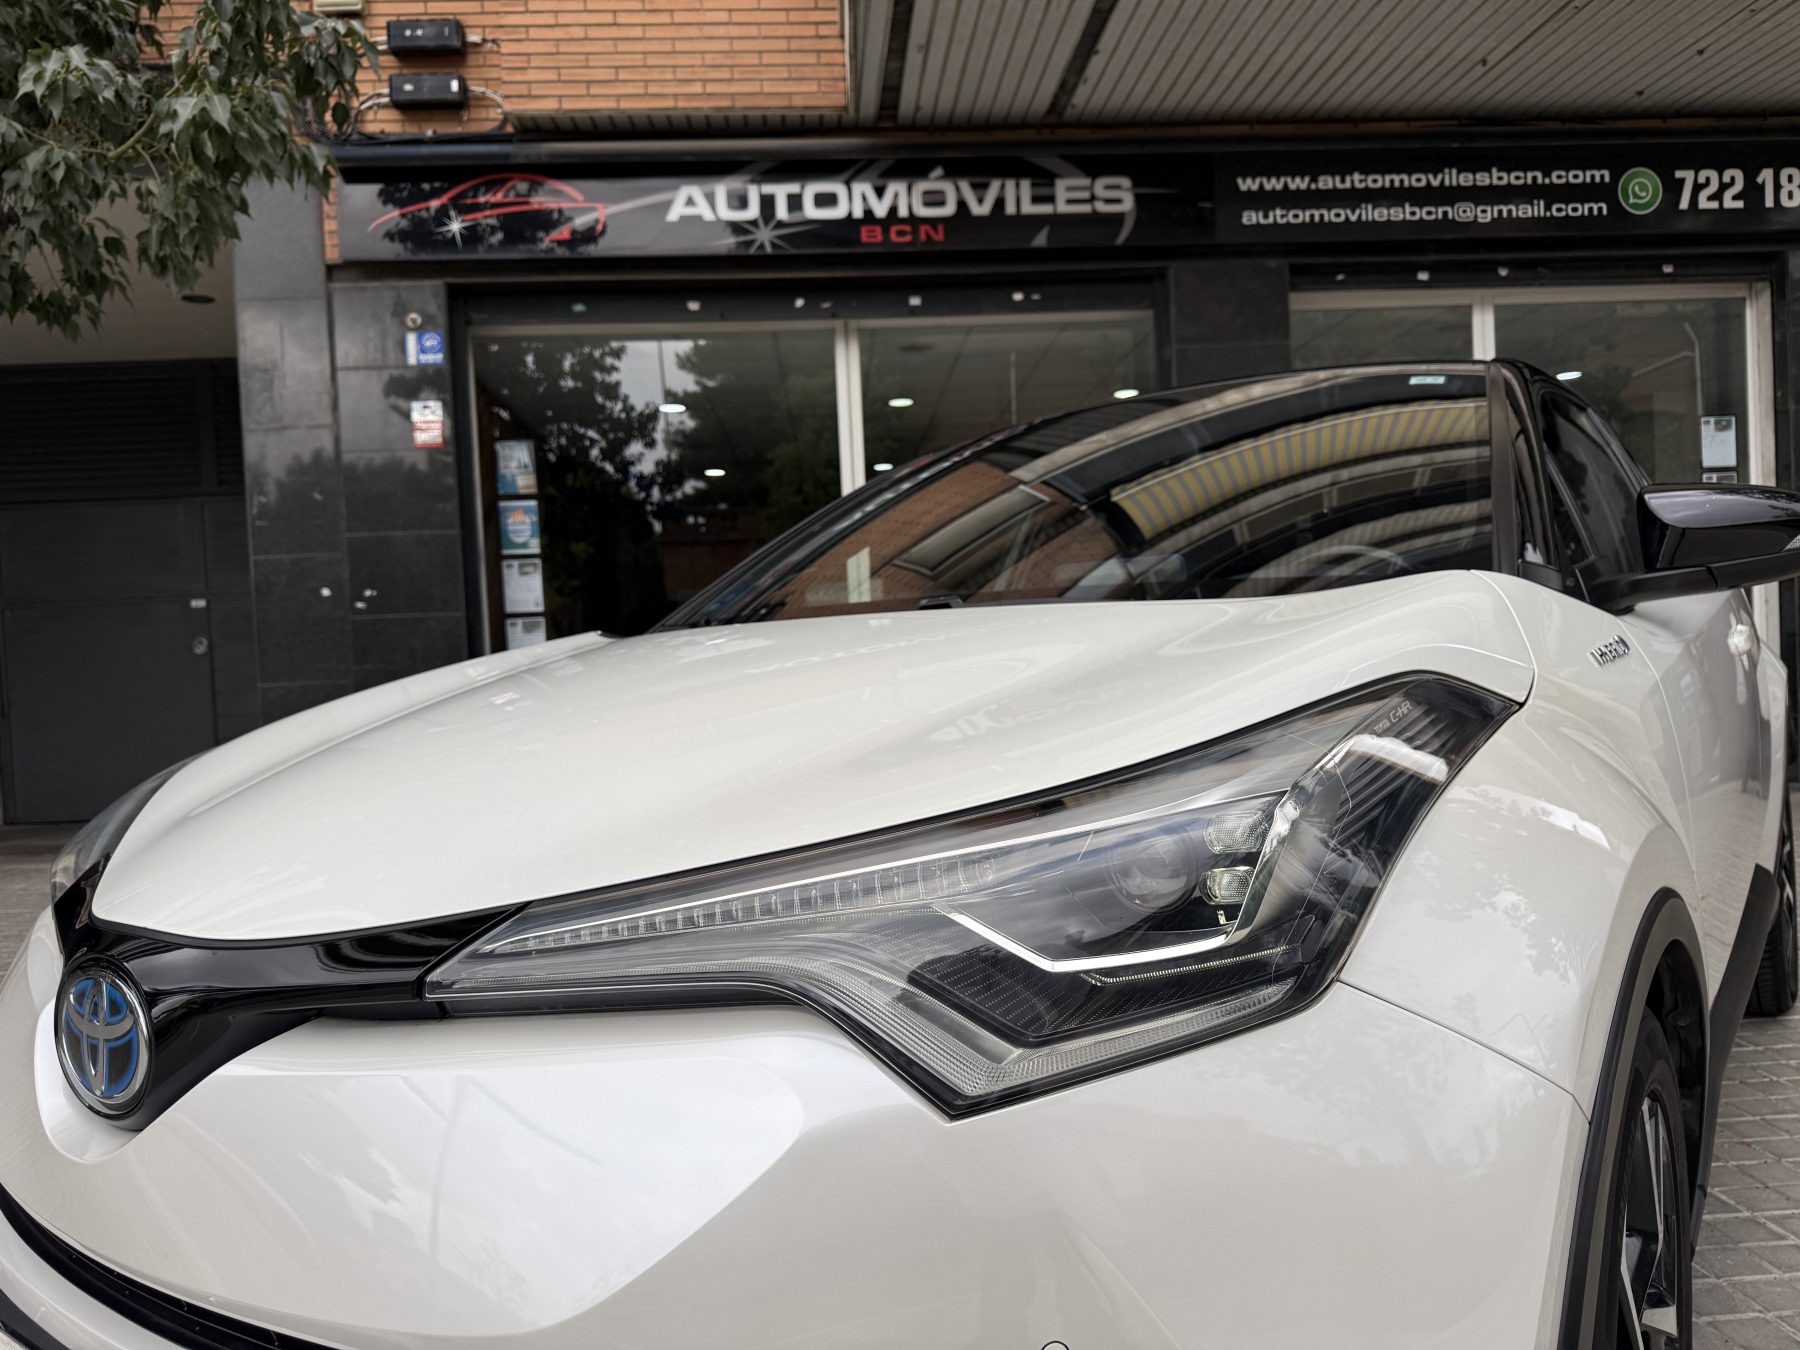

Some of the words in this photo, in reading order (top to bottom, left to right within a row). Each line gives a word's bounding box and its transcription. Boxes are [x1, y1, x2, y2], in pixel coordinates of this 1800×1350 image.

[1235, 166, 1611, 193] www.automovilesbcn.com
[1674, 167, 1745, 211] 722
[1755, 166, 1800, 209] 18
[665, 166, 1135, 223] AUTOMÓVILES
[1240, 199, 1608, 226] automovilesbcn@gmail.com
[859, 224, 946, 244] BCN
